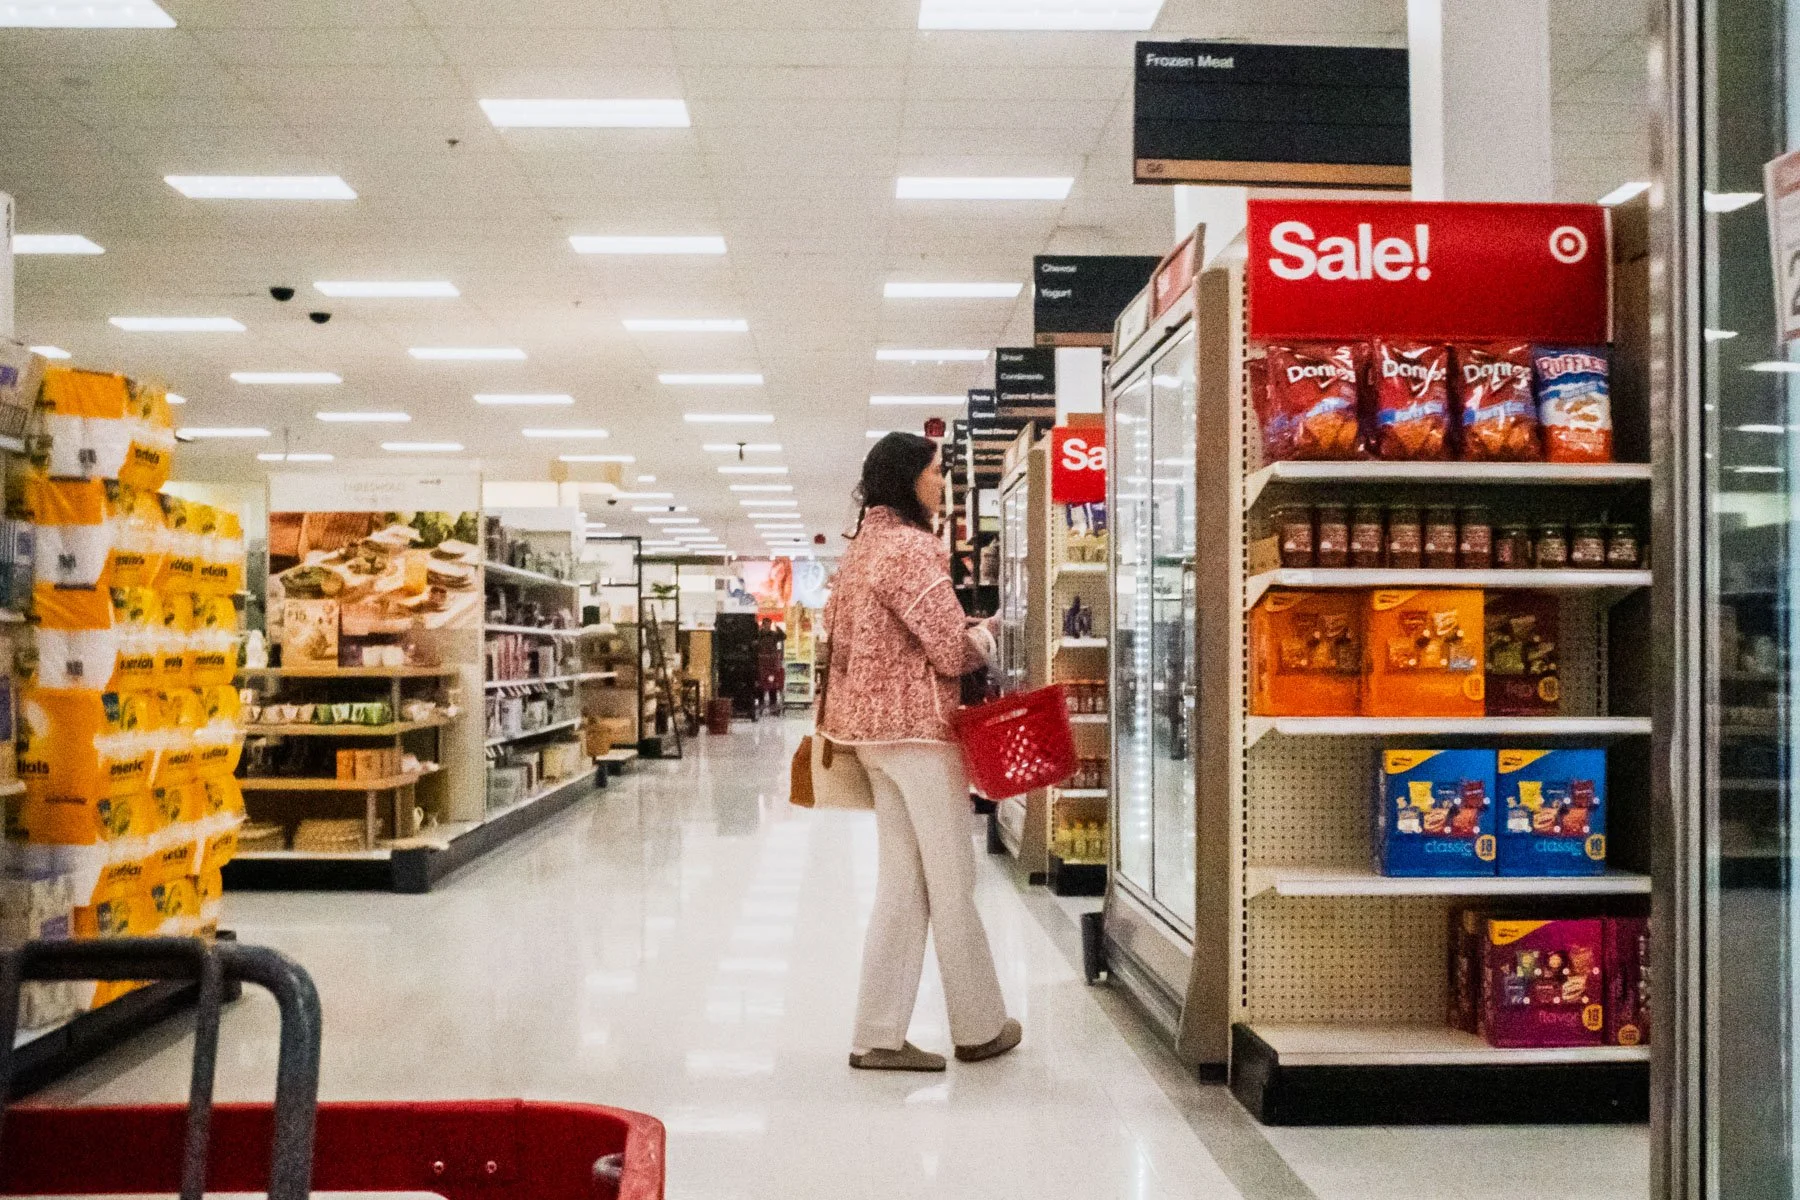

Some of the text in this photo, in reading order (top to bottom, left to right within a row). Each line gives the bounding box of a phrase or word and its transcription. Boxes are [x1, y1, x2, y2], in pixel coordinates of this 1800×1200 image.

[1146, 53, 1234, 68] Frozen Meat
[1268, 221, 1431, 281] Sale!
[1040, 288, 1072, 299] Yogurt
[1424, 839, 1473, 853] classic
[1534, 838, 1583, 852] classic
